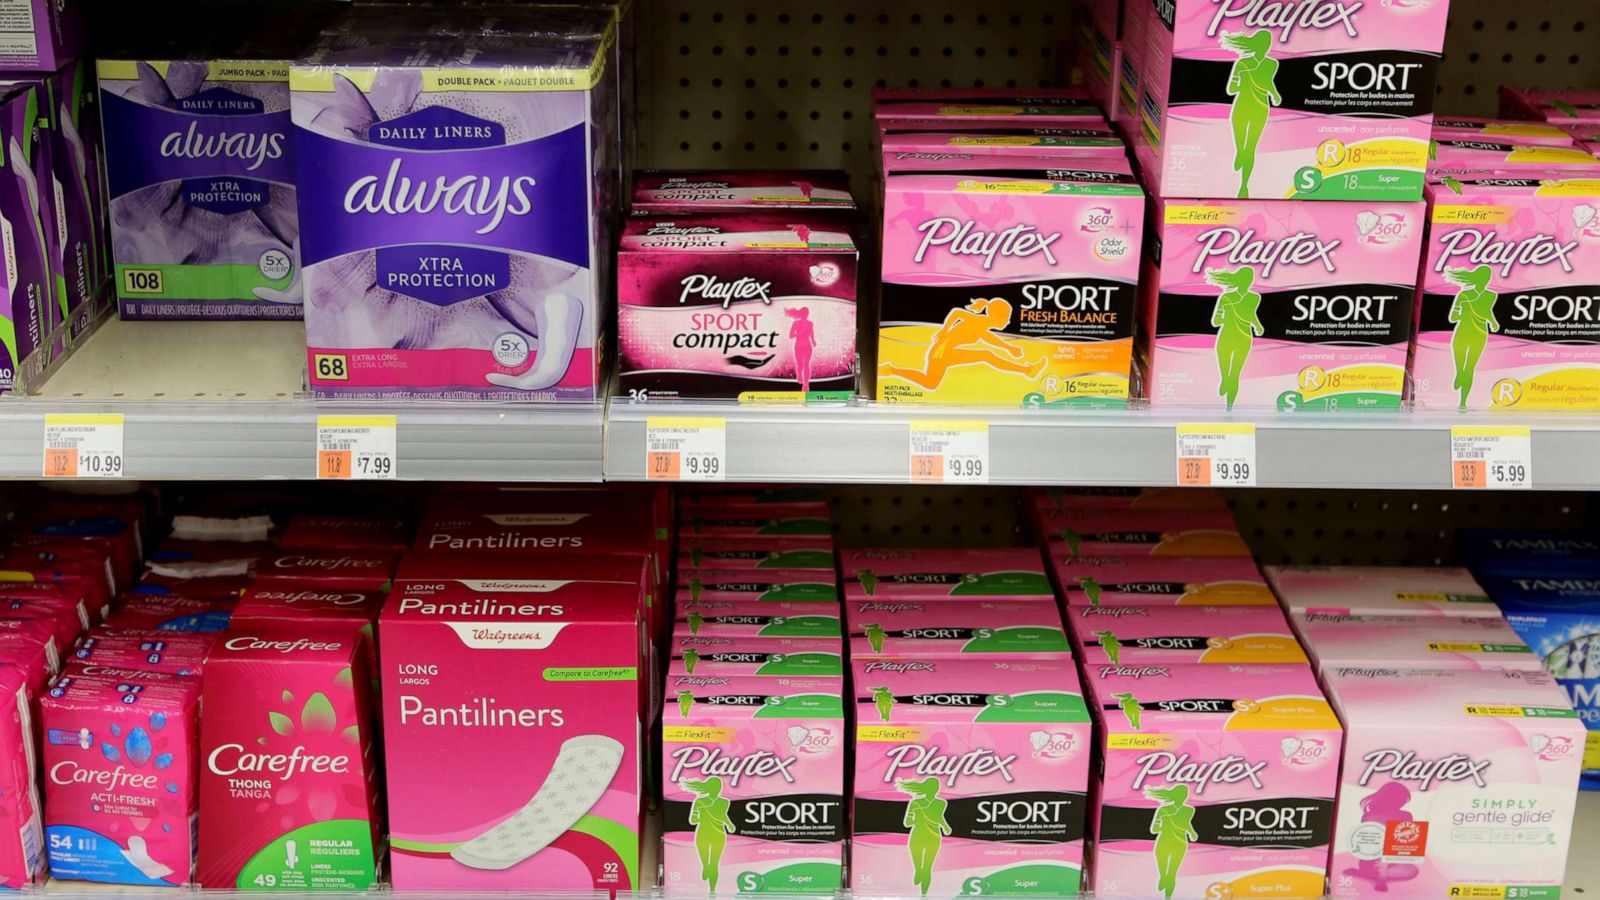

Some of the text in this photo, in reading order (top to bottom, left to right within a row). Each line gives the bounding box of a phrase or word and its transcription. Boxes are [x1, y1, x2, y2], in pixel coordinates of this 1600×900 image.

[218, 69, 265, 77] JUMBO PACK
[1311, 62, 1418, 91] SPORT
[438, 77, 575, 87] DOUBLE PACK PAQUET DOUBLE
[182, 100, 255, 110] DAILY LINERS
[380, 126, 492, 139] DAILY LINERS
[1318, 125, 1355, 133] unscented
[160, 120, 285, 171] always
[1323, 143, 1389, 163] R 18 Regular
[1047, 170, 1119, 180] SPORT
[1301, 170, 1315, 190] S
[1343, 175, 1358, 190] 18
[1378, 174, 1400, 184] Super
[210, 182, 240, 192] XTRA
[1079, 186, 1092, 194] 16
[190, 192, 261, 202] PROTECTION
[344, 158, 537, 235] always
[654, 193, 736, 201] compact
[1188, 211, 1220, 221] FlexFit
[1457, 210, 1488, 220] FlexFit
[641, 240, 728, 248] compact
[914, 217, 1062, 269] Playtex
[1101, 238, 1122, 248] Odor
[1100, 247, 1124, 256] Shield
[1191, 228, 1340, 278] Playtex
[1434, 229, 1578, 278] Playtex
[419, 257, 463, 271] XTRA
[128, 272, 160, 290] 108
[388, 273, 496, 288] PROTECTION
[679, 275, 771, 308] Playtex
[1020, 285, 1119, 311] SPORT
[1292, 295, 1393, 321] SPORT
[691, 313, 763, 331] SPORT
[1020, 310, 1117, 324] FRESH BALANCE
[672, 331, 779, 354] compact
[1299, 352, 1335, 360] unscented
[1520, 351, 1556, 359] unscented
[318, 357, 345, 376] 68
[1045, 379, 1076, 393] R 16
[1305, 369, 1341, 388] R 18
[628, 389, 648, 402] 36
[1500, 383, 1564, 401] R Regular
[1284, 394, 1378, 412] S Super
[80, 455, 121, 472] $10.99
[357, 457, 391, 474] $7.99
[686, 457, 719, 474] $9.99
[949, 459, 982, 476] $9.99
[1216, 463, 1250, 480] $9.99
[1492, 465, 1525, 482] $5.99
[428, 533, 583, 549] Pantiliners
[275, 555, 382, 570] Carefree
[398, 598, 564, 616] Pantiliners
[472, 628, 542, 644] Walgreens
[902, 629, 991, 638] SPORT S
[225, 636, 342, 654] Carefree
[1136, 639, 1196, 648] SPORT
[712, 654, 757, 662] SPORT
[398, 664, 438, 676] LONG
[549, 669, 582, 679] Compare
[708, 696, 781, 705] SPORT S
[912, 695, 973, 705] SPORT
[993, 695, 1007, 706] S
[1158, 701, 1219, 712] SPORT
[400, 695, 565, 727] Pantiliners
[1467, 707, 1477, 715] R
[684, 731, 712, 739] FlexFit
[878, 731, 906, 739] FlexFit
[1129, 738, 1156, 747] FlexFit
[208, 743, 348, 781] Carefree
[671, 746, 796, 787] Playtex
[883, 745, 1016, 787] Playtex
[50, 760, 158, 791] Carefree
[1132, 751, 1267, 795] Playtex
[1359, 749, 1491, 791] Playtex
[228, 779, 272, 789] THONG
[90, 792, 156, 806] ACTI-FRESH
[229, 789, 272, 799] TANGA
[1472, 798, 1538, 809] SIMPLY
[745, 802, 835, 824] SPORT
[976, 801, 1067, 823] SPORT
[1223, 807, 1315, 829] SPORT
[1452, 810, 1552, 827] gentle glide
[50, 834, 72, 849] 54
[310, 839, 353, 848] REGULAR
[310, 847, 360, 856] RÉGULIERS
[603, 862, 618, 873] 92
[254, 874, 276, 887] 49
[744, 874, 813, 890] S Super
[969, 879, 981, 895] S
[1014, 879, 1039, 888] Super
[1337, 877, 1519, 898] 36 R 18 S
[1250, 884, 1292, 894] Super Plus
